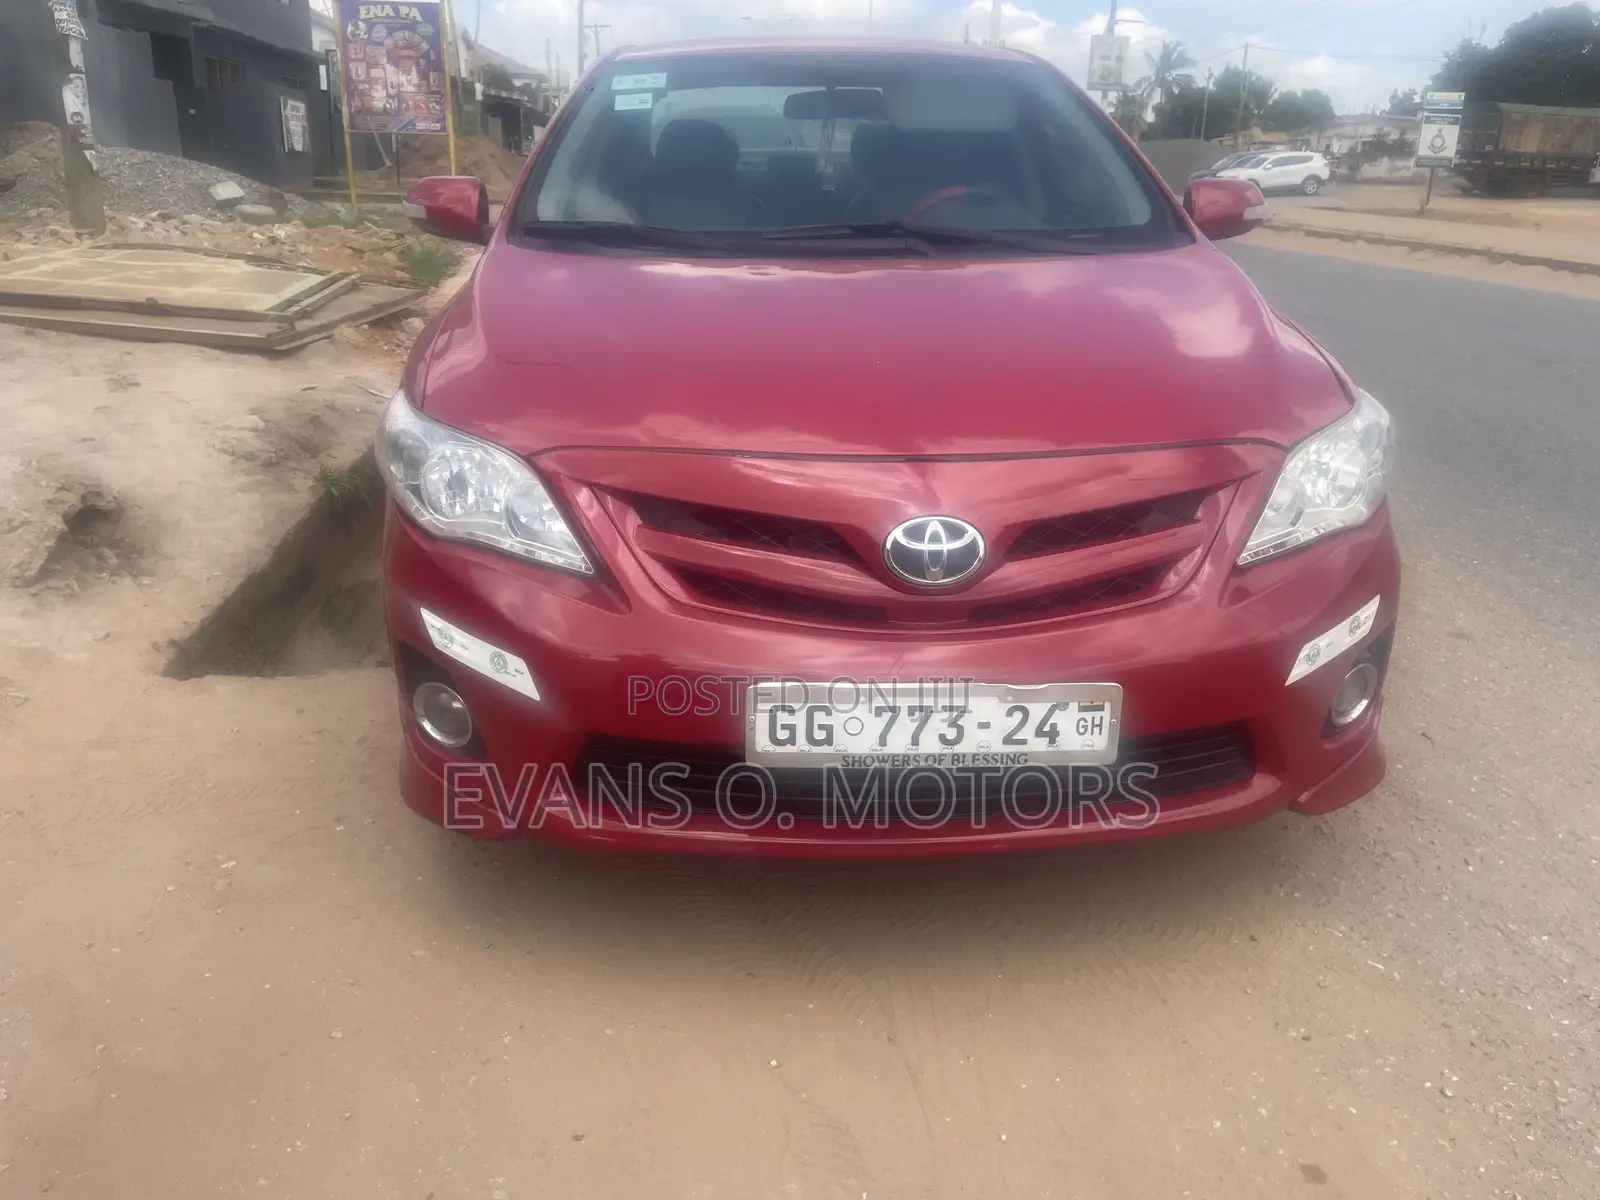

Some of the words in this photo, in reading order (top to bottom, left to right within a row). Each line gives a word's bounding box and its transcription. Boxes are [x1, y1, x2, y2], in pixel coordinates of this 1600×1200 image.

[359, 5, 396, 19] ENA
[398, 5, 424, 21] PA
[768, 704, 834, 747] GG
[1075, 716, 1104, 736] GH
[841, 754, 921, 768] SHOWERS
[924, 753, 947, 767] OF
[951, 752, 1028, 766] BLESSING
